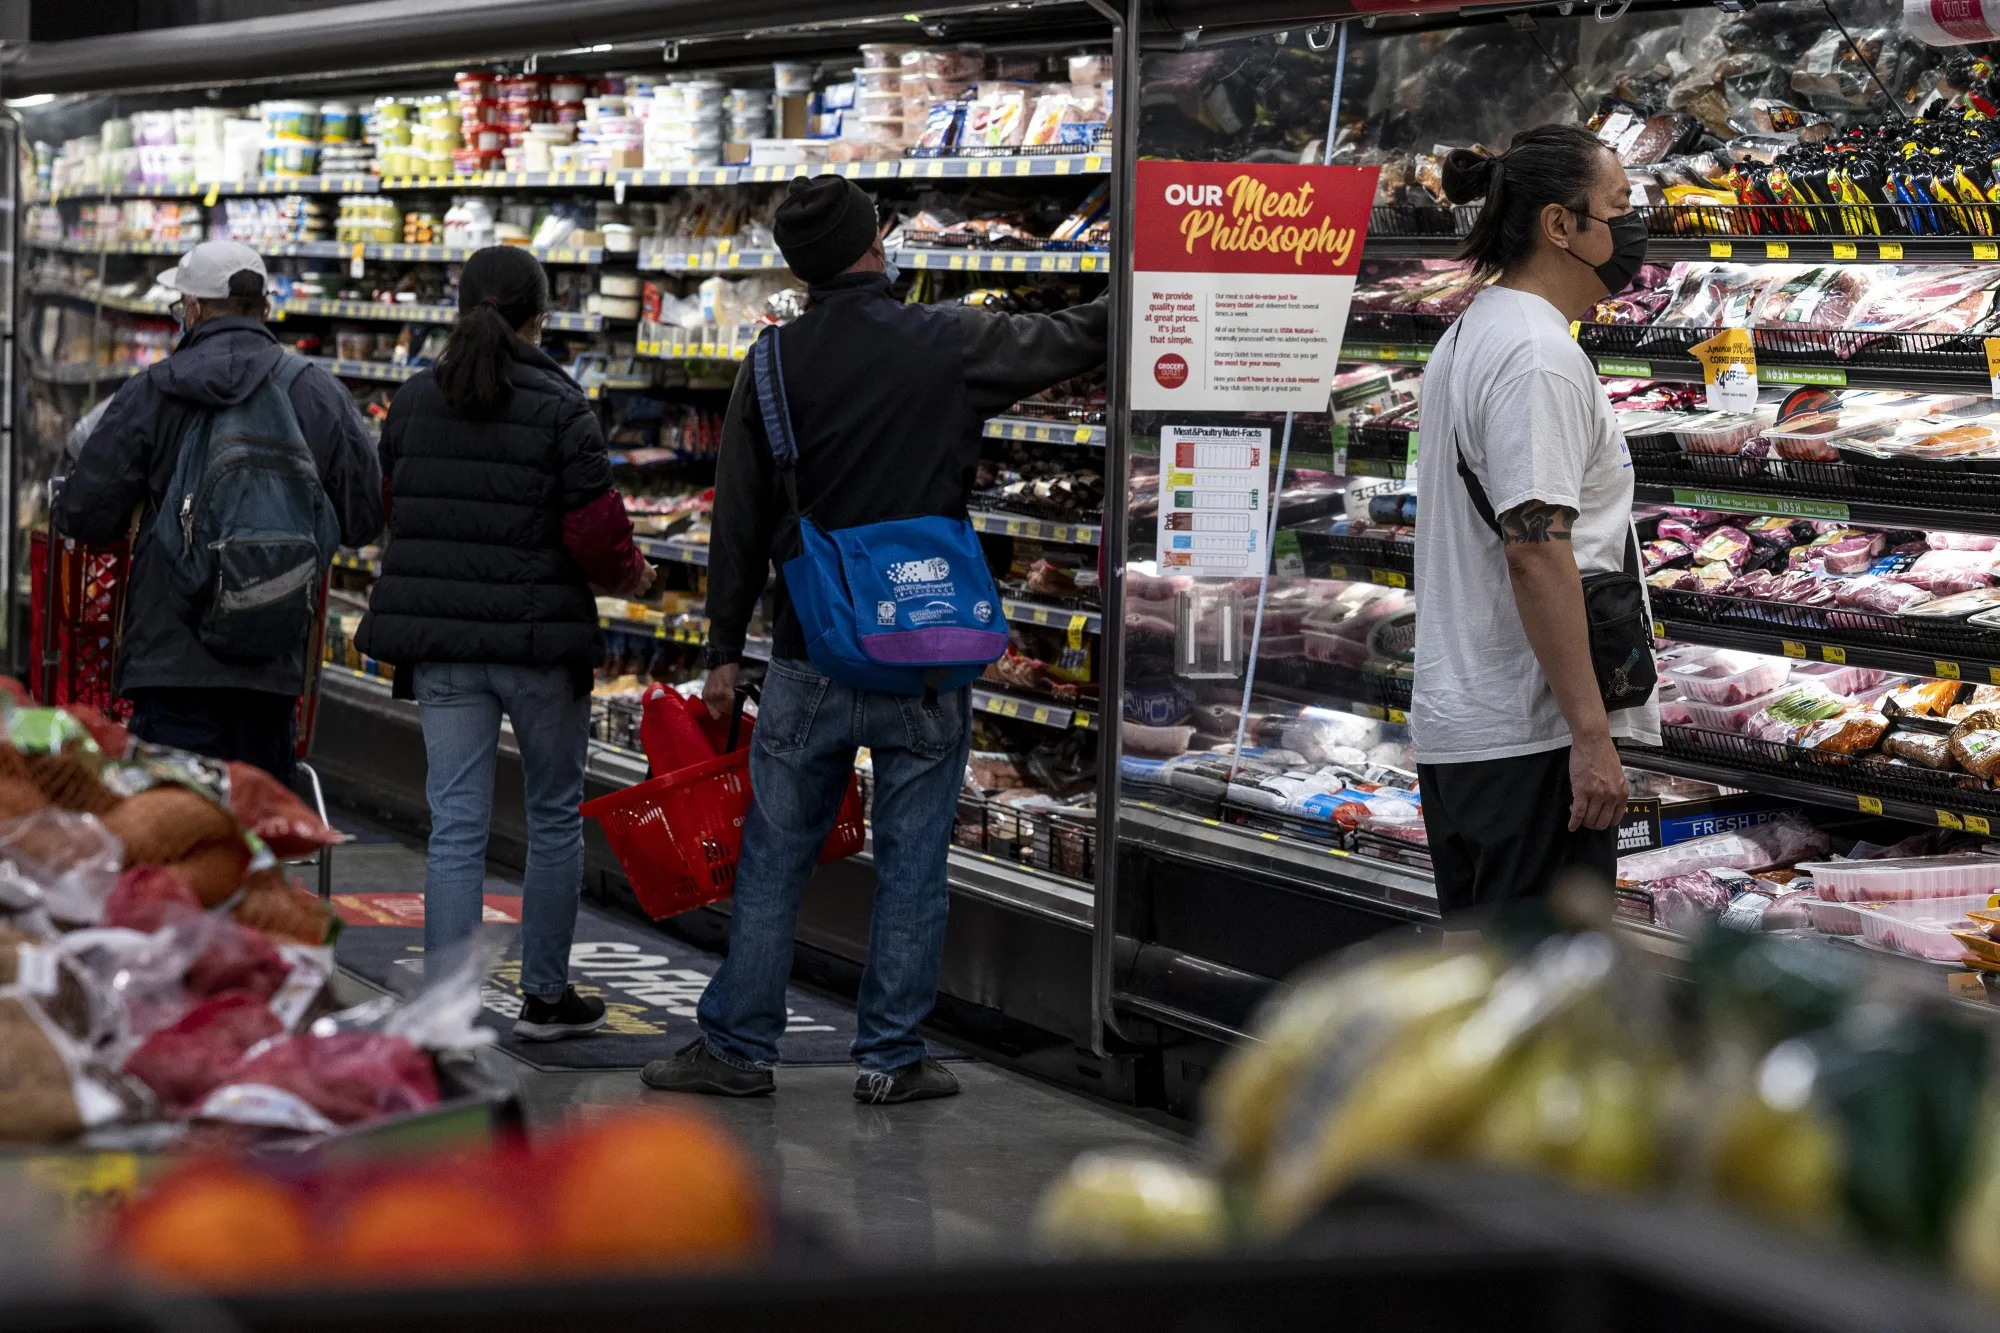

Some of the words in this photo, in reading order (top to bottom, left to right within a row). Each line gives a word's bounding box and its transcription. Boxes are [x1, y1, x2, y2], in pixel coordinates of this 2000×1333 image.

[1941, 1, 1971, 18] OUTLET
[1165, 184, 1223, 206] OUR
[1226, 174, 1315, 222] Meat
[1180, 209, 1356, 266] Philosophy
[1152, 292, 1164, 300] We
[1165, 292, 1193, 301] provide
[1149, 303, 1174, 312] quality
[1154, 314, 1173, 323] great
[1175, 315, 1200, 323] prices.
[1158, 325, 1169, 333] It's
[1170, 325, 1186, 334] just
[1150, 336, 1165, 344] that
[1167, 336, 1194, 345] simple.
[1214, 351, 1233, 359] Grocery
[1730, 356, 1740, 364] BEEF
[1716, 368, 1725, 389] $4
[1725, 370, 1737, 382] OFF
[1765, 368, 1789, 380] NOSH
[1223, 428, 1262, 438] Nutri-Facts
[1251, 447, 1261, 467] Beef
[1250, 489, 1259, 510] Lamb
[1695, 493, 1718, 506] NOSH
[1777, 501, 1801, 513] NOSH
[1618, 820, 1650, 839] wift
[1692, 816, 1749, 836] FRESH
